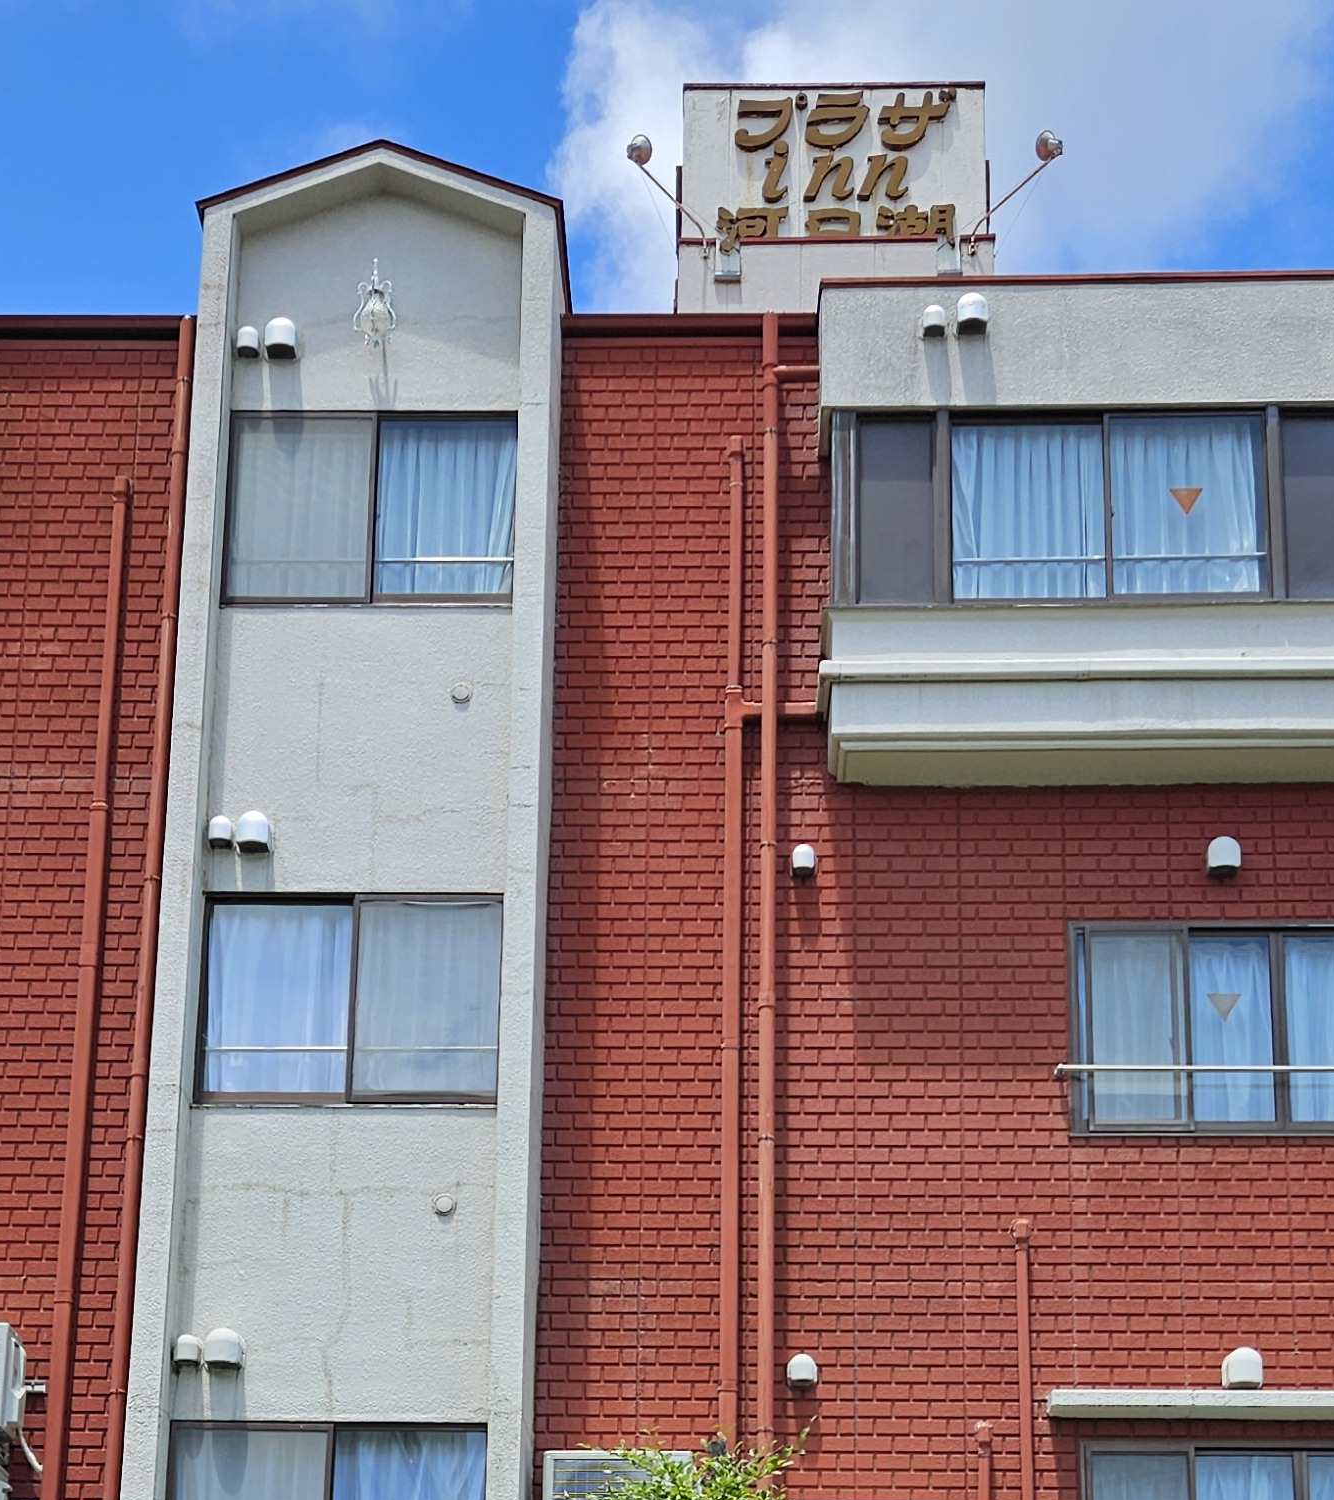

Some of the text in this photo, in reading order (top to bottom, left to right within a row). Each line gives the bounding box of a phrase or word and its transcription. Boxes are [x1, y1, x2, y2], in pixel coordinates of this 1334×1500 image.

[734, 87, 958, 152] プラザ
[761, 140, 909, 203] inn
[715, 204, 957, 252] 河口湖
